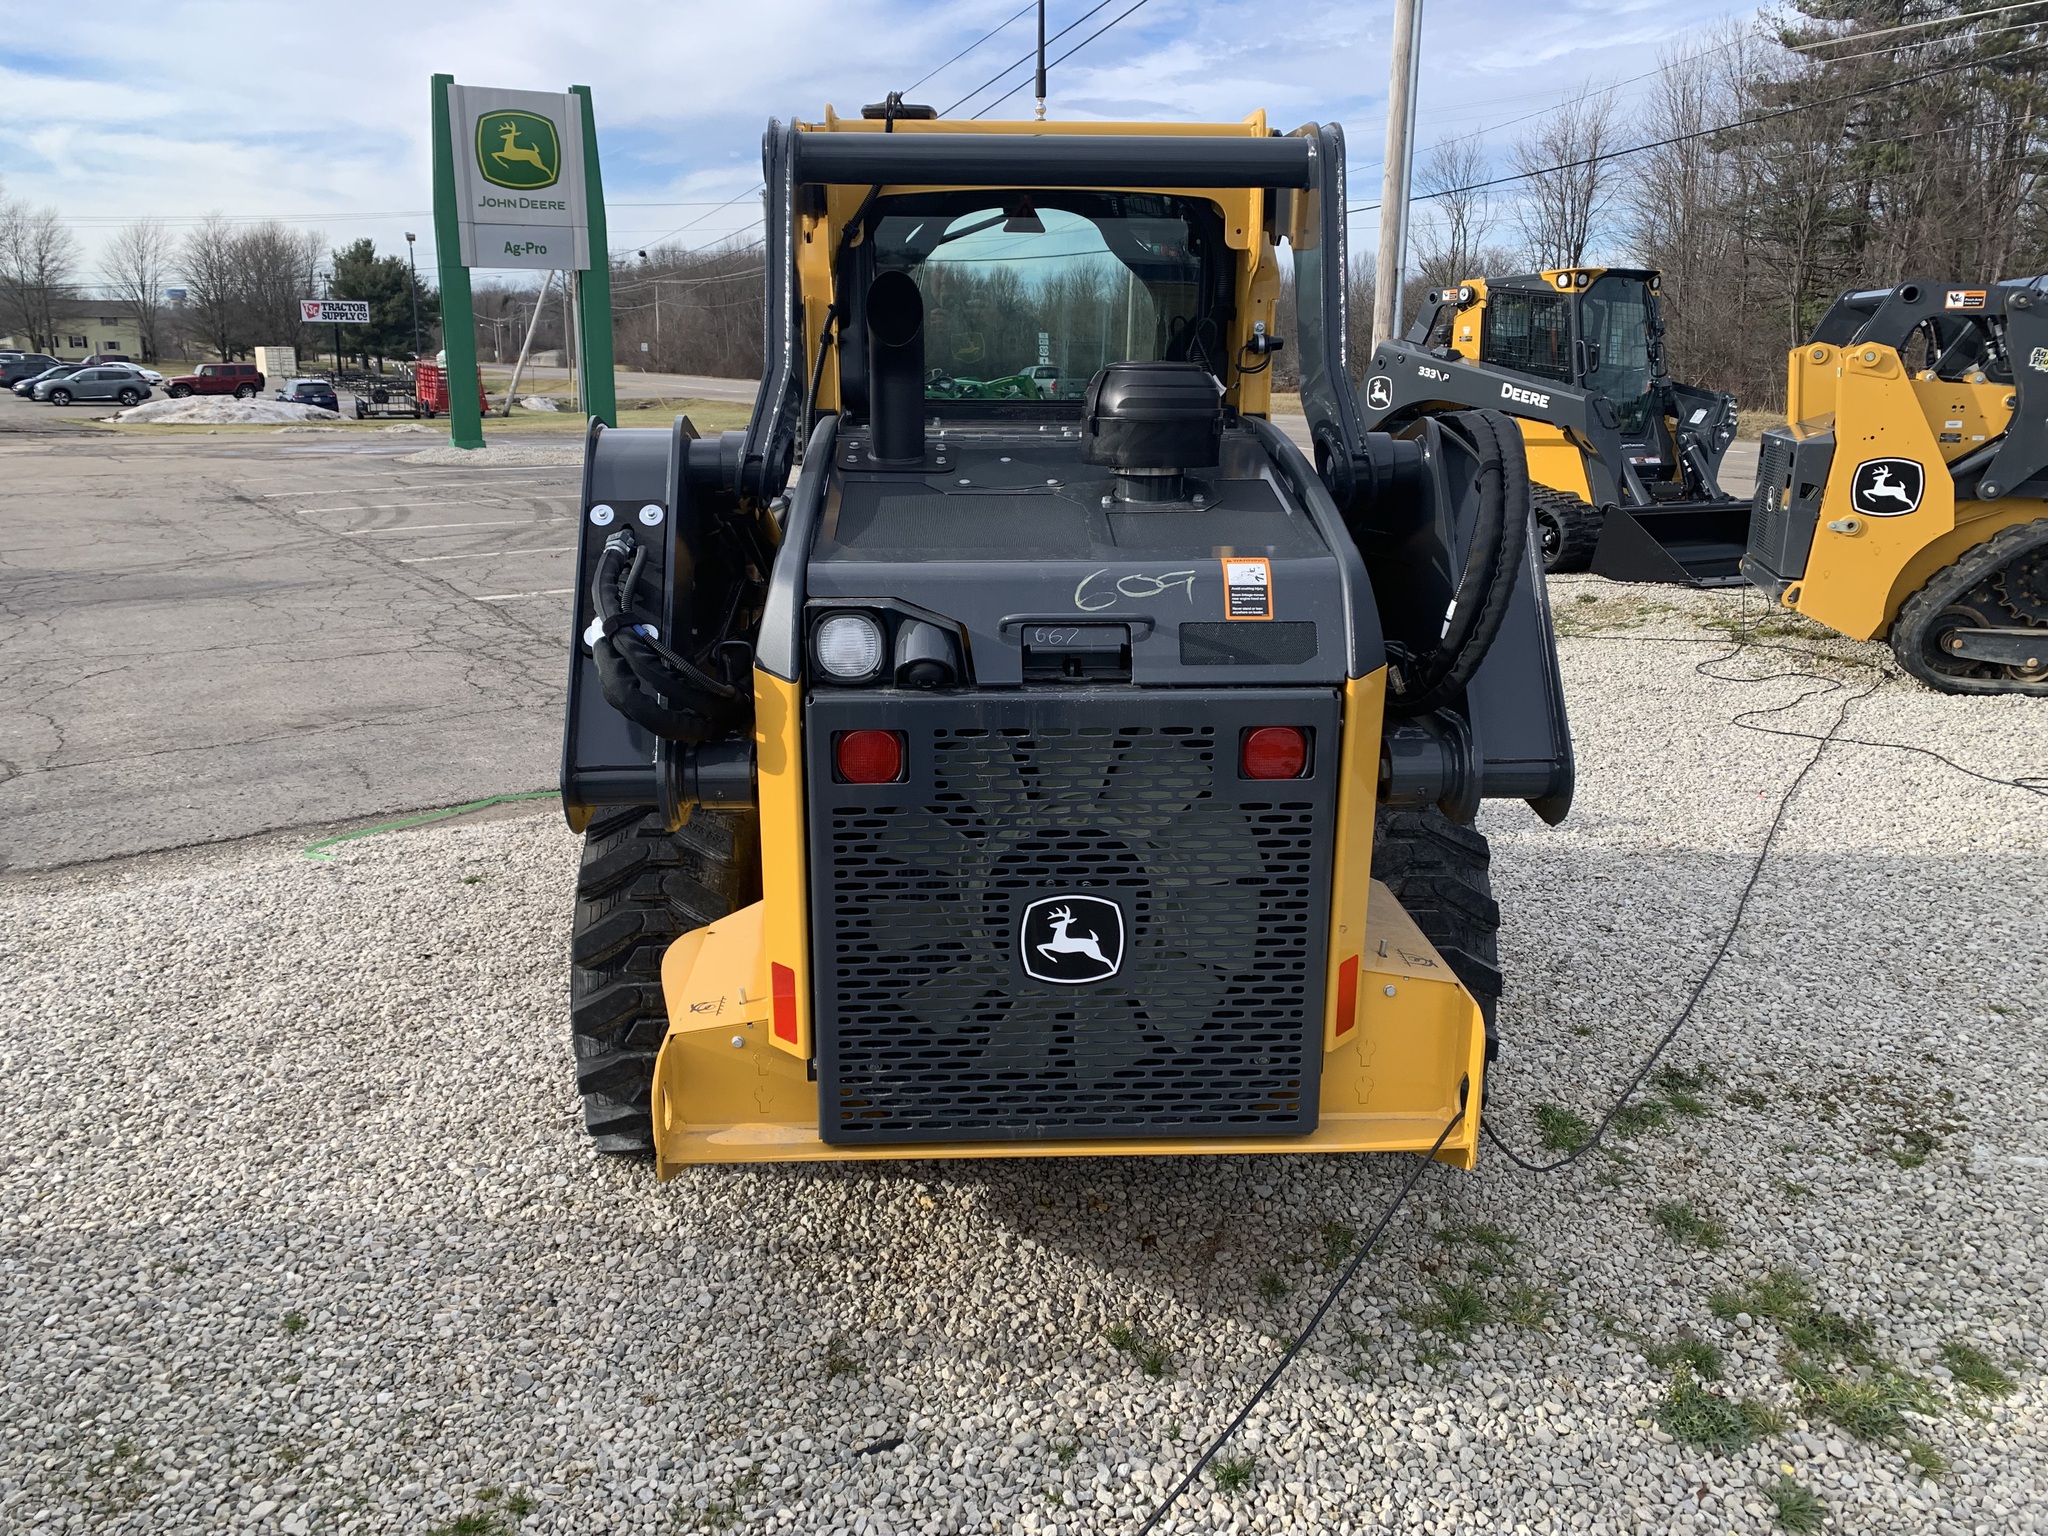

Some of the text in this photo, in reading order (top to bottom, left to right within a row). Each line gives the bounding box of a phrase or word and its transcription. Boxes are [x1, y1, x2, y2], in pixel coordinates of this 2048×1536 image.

[478, 196, 566, 210] JOHN DEERE
[503, 241, 547, 256] Ag-Pro
[303, 303, 318, 316] TSC
[321, 302, 367, 312] TRACTOR
[321, 312, 356, 320] SUPPLY
[1500, 382, 1551, 409] DEERE
[1035, 627, 1079, 645] 667
